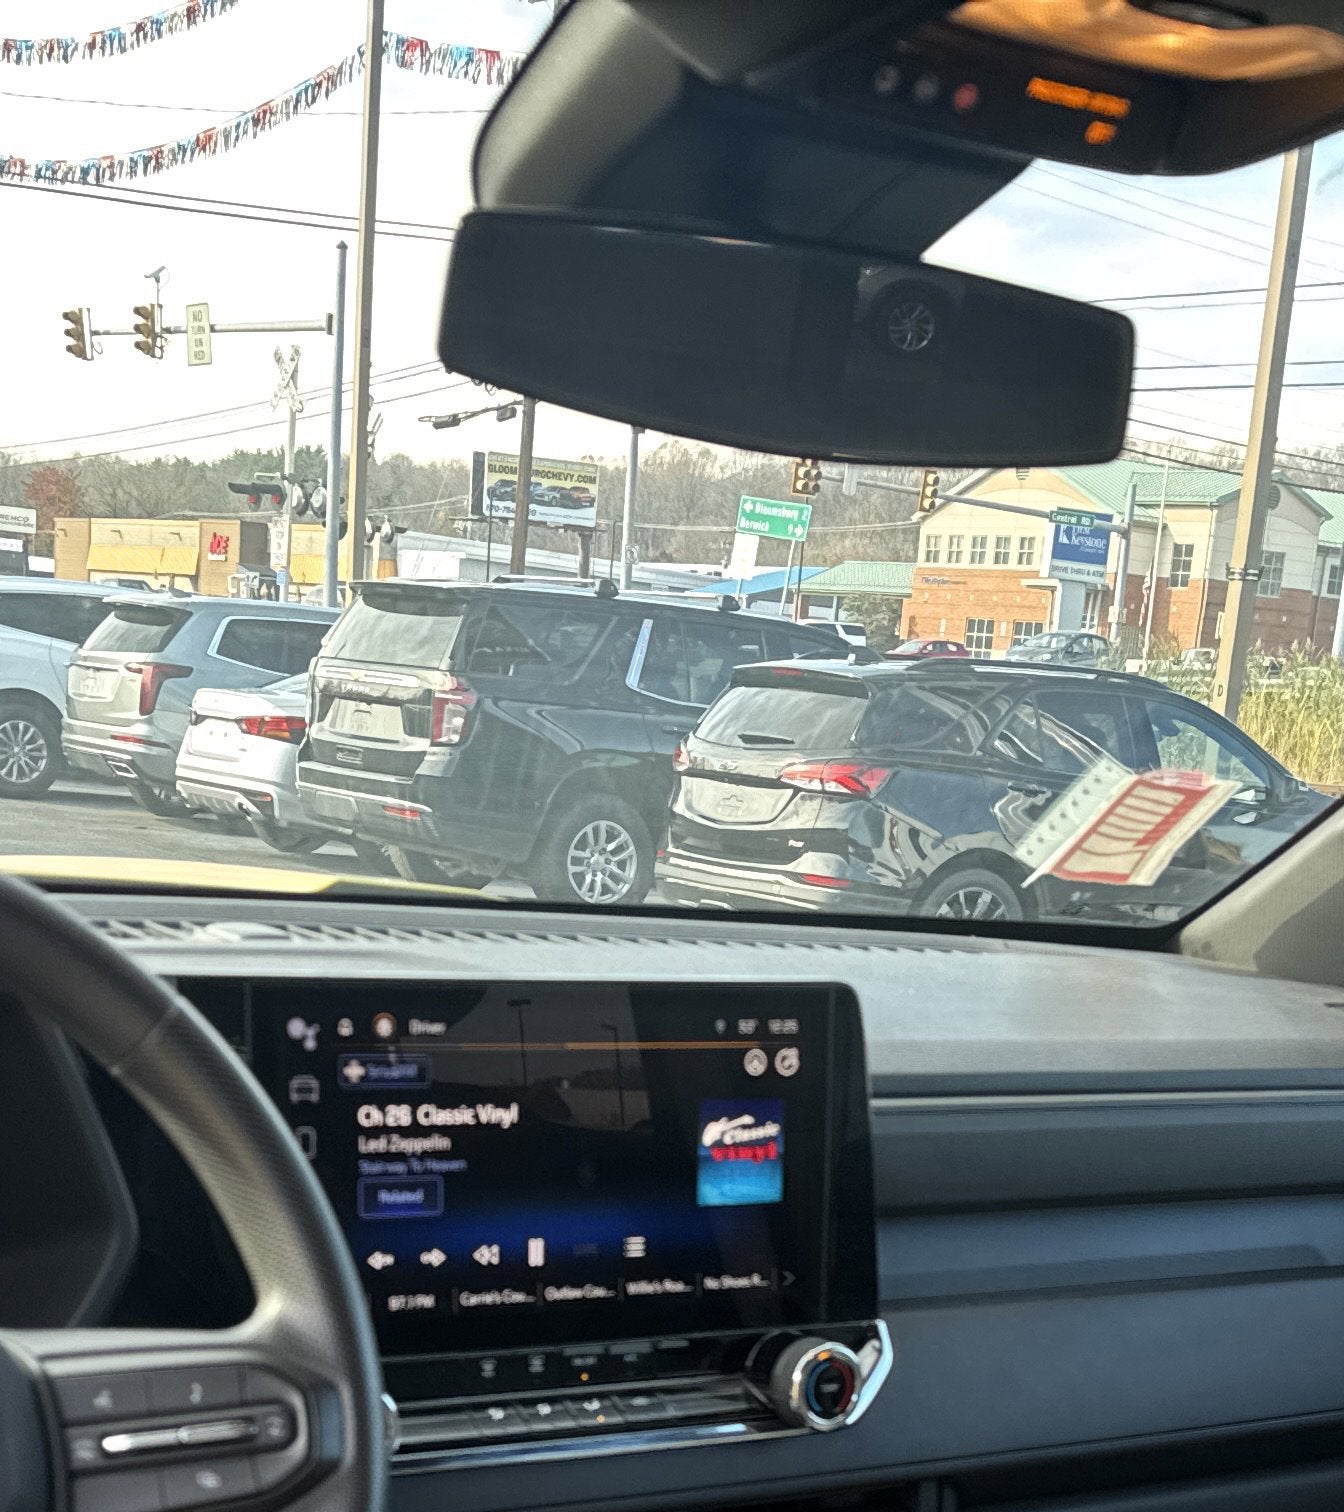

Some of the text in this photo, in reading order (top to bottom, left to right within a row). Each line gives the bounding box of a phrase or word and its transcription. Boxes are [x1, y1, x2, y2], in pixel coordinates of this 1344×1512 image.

[192, 309, 203, 323] NO
[755, 502, 809, 521] Bloomsburg 2
[1052, 513, 1078, 524] Central
[740, 517, 769, 532] Berwick
[1071, 536, 1107, 549] Keystone
[357, 1103, 384, 1127] Ch
[416, 1103, 476, 1126] Classic
[476, 1102, 520, 1129] Vinyl
[358, 1133, 452, 1156] Led Zeppelin
